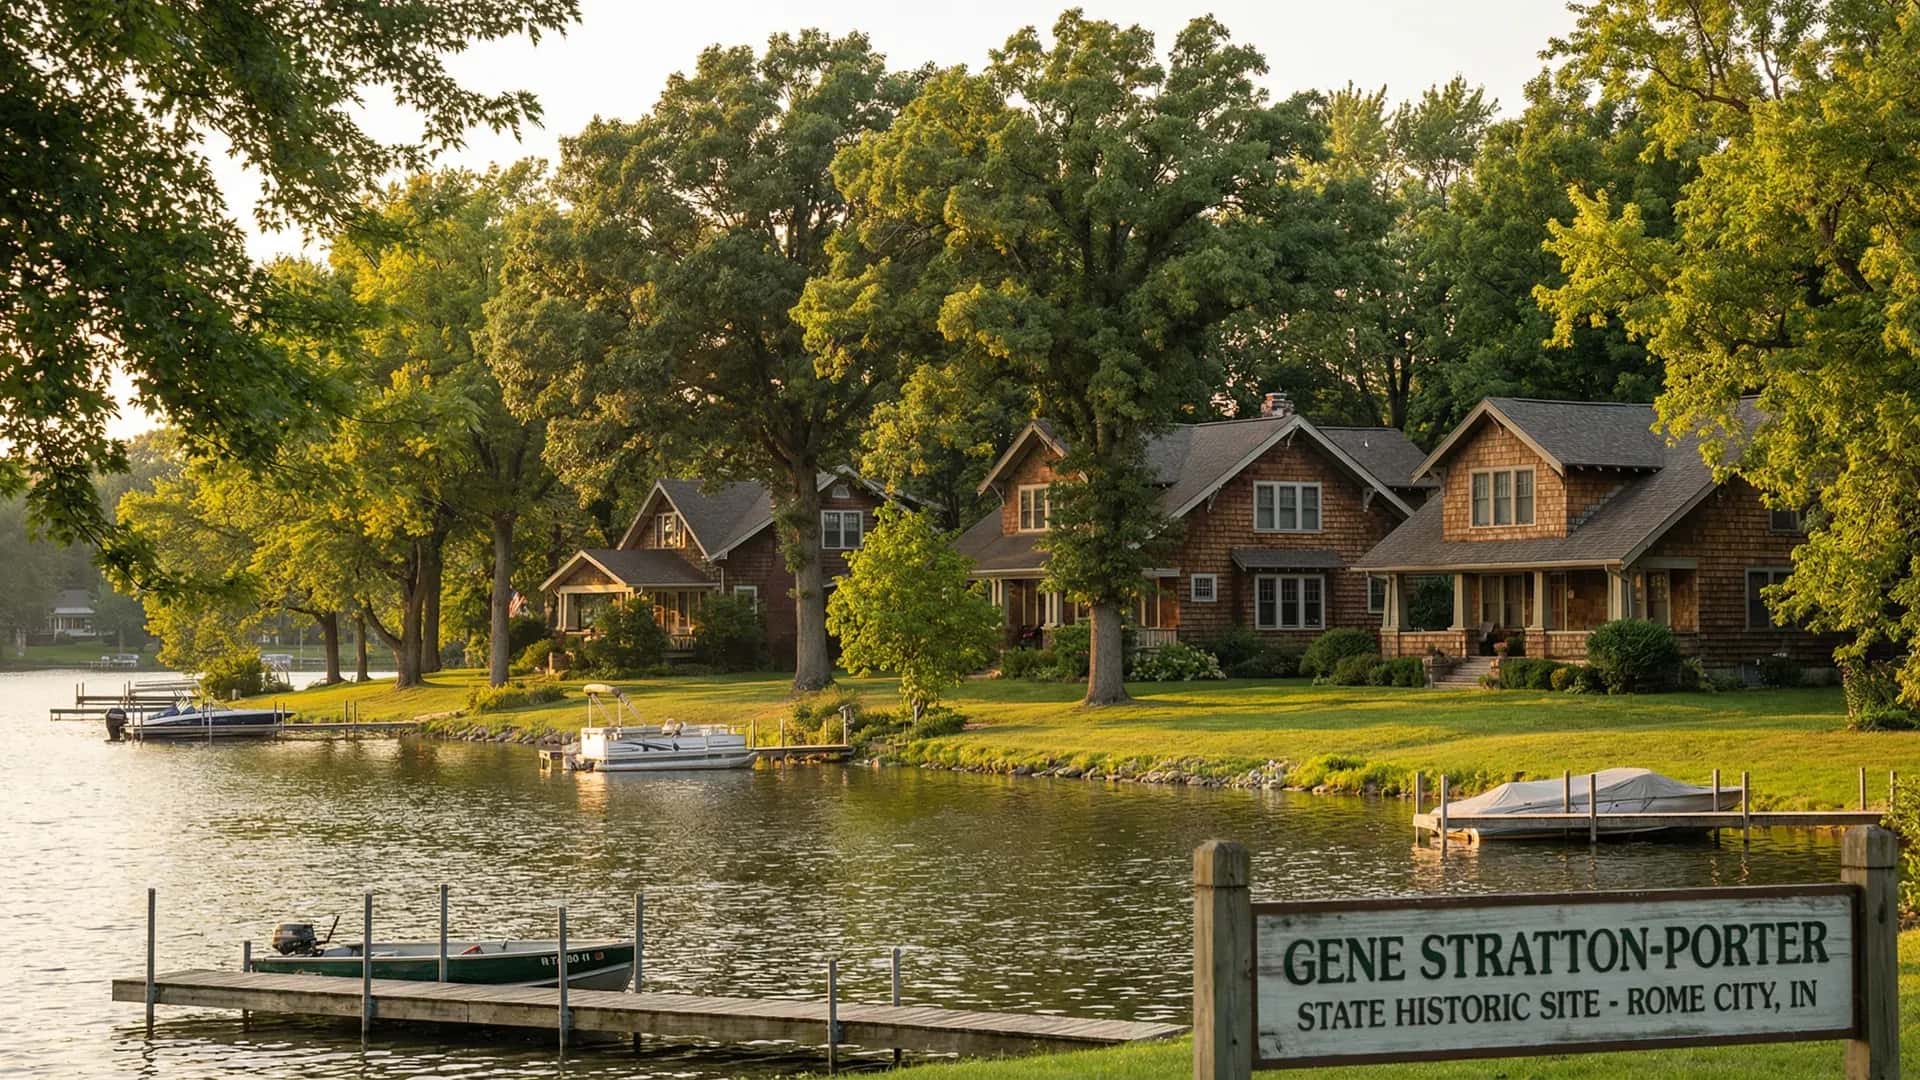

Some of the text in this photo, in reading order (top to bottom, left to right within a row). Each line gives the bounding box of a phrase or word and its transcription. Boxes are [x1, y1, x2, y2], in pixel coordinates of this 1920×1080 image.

[1283, 920, 1831, 987] GENE STRATTON-PORTER
[1297, 999, 1387, 1032] STATE
[1395, 992, 1531, 1027] HISTORIC
[1539, 989, 1601, 1021] SITE
[1627, 984, 1706, 1016] ROME
[1713, 980, 1781, 1014] CITY,
[1789, 979, 1818, 1009] IN
